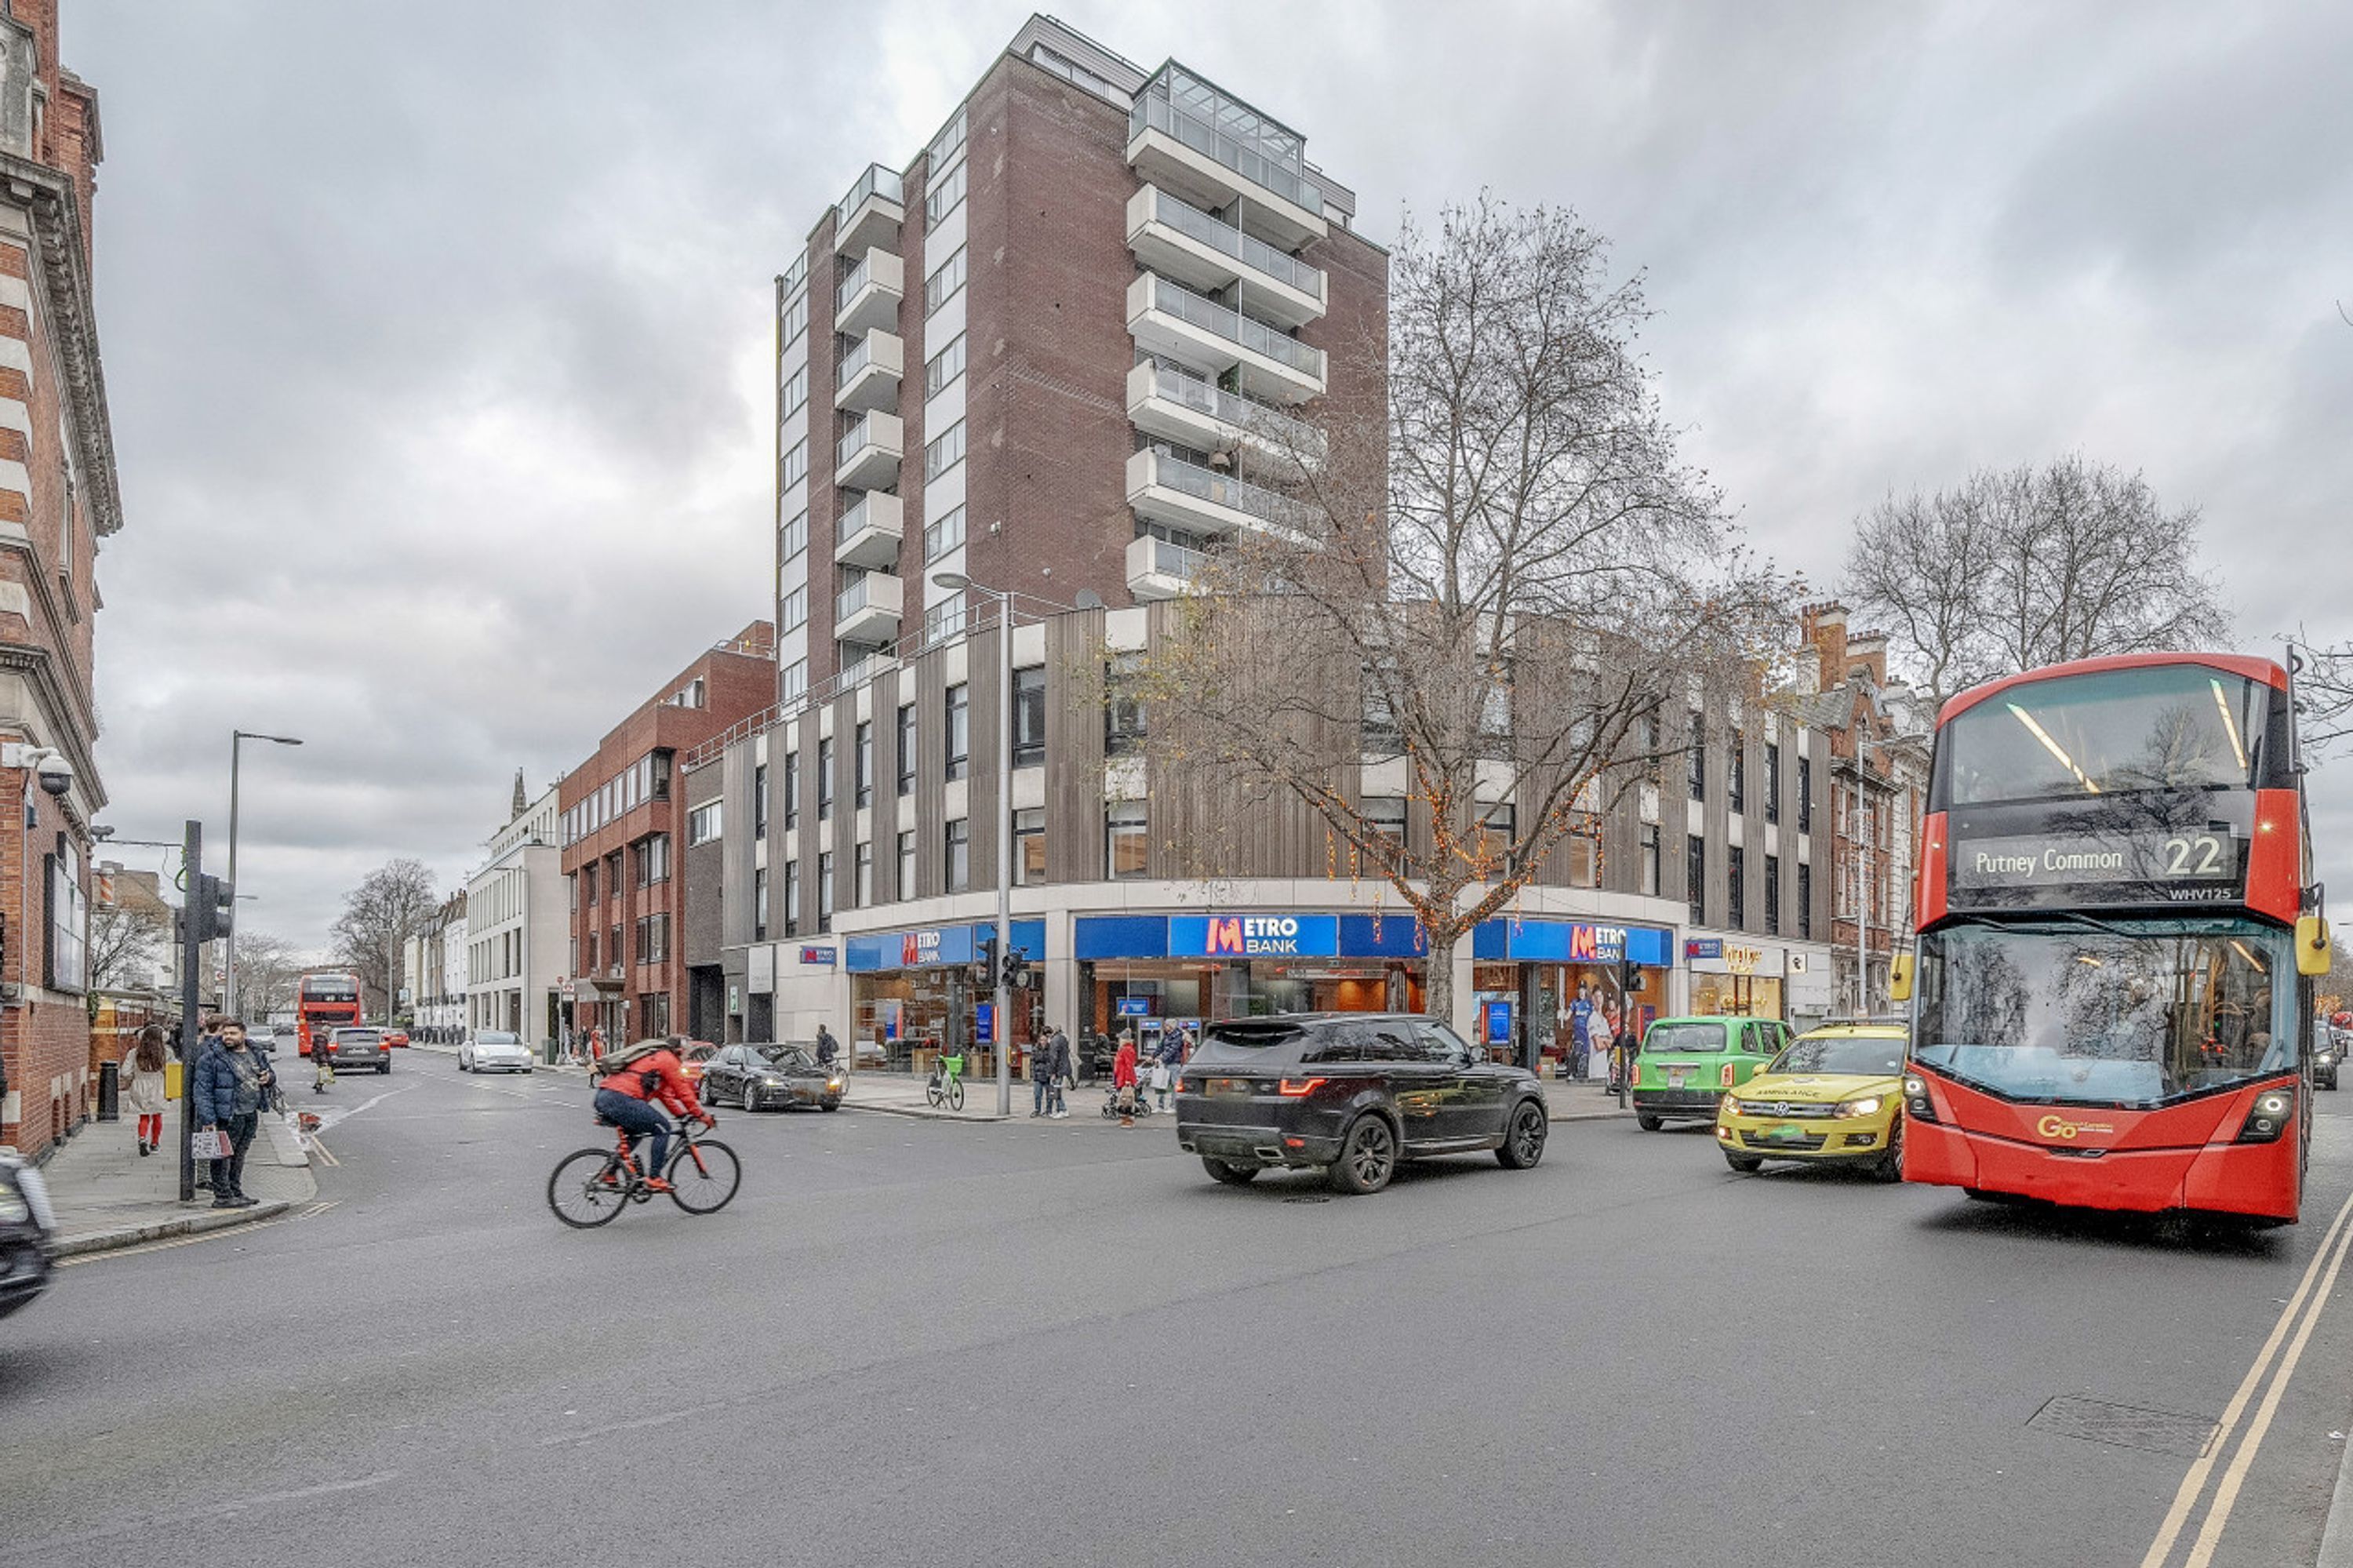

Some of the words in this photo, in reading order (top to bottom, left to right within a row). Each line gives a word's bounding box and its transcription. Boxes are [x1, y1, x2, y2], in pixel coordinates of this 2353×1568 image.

[1976, 852, 2037, 878] Putney
[2044, 849, 2122, 871] Common
[2165, 836, 2221, 875] 22
[2169, 888, 2231, 900] WHV125
[1206, 916, 1298, 953] METRO
[1246, 939, 1298, 953] BANK
[1570, 925, 1627, 959] METRO
[902, 932, 940, 965] METRO
[918, 950, 940, 963] BANK
[1597, 946, 1622, 959] BAN
[2037, 1115, 2078, 1139] Go
